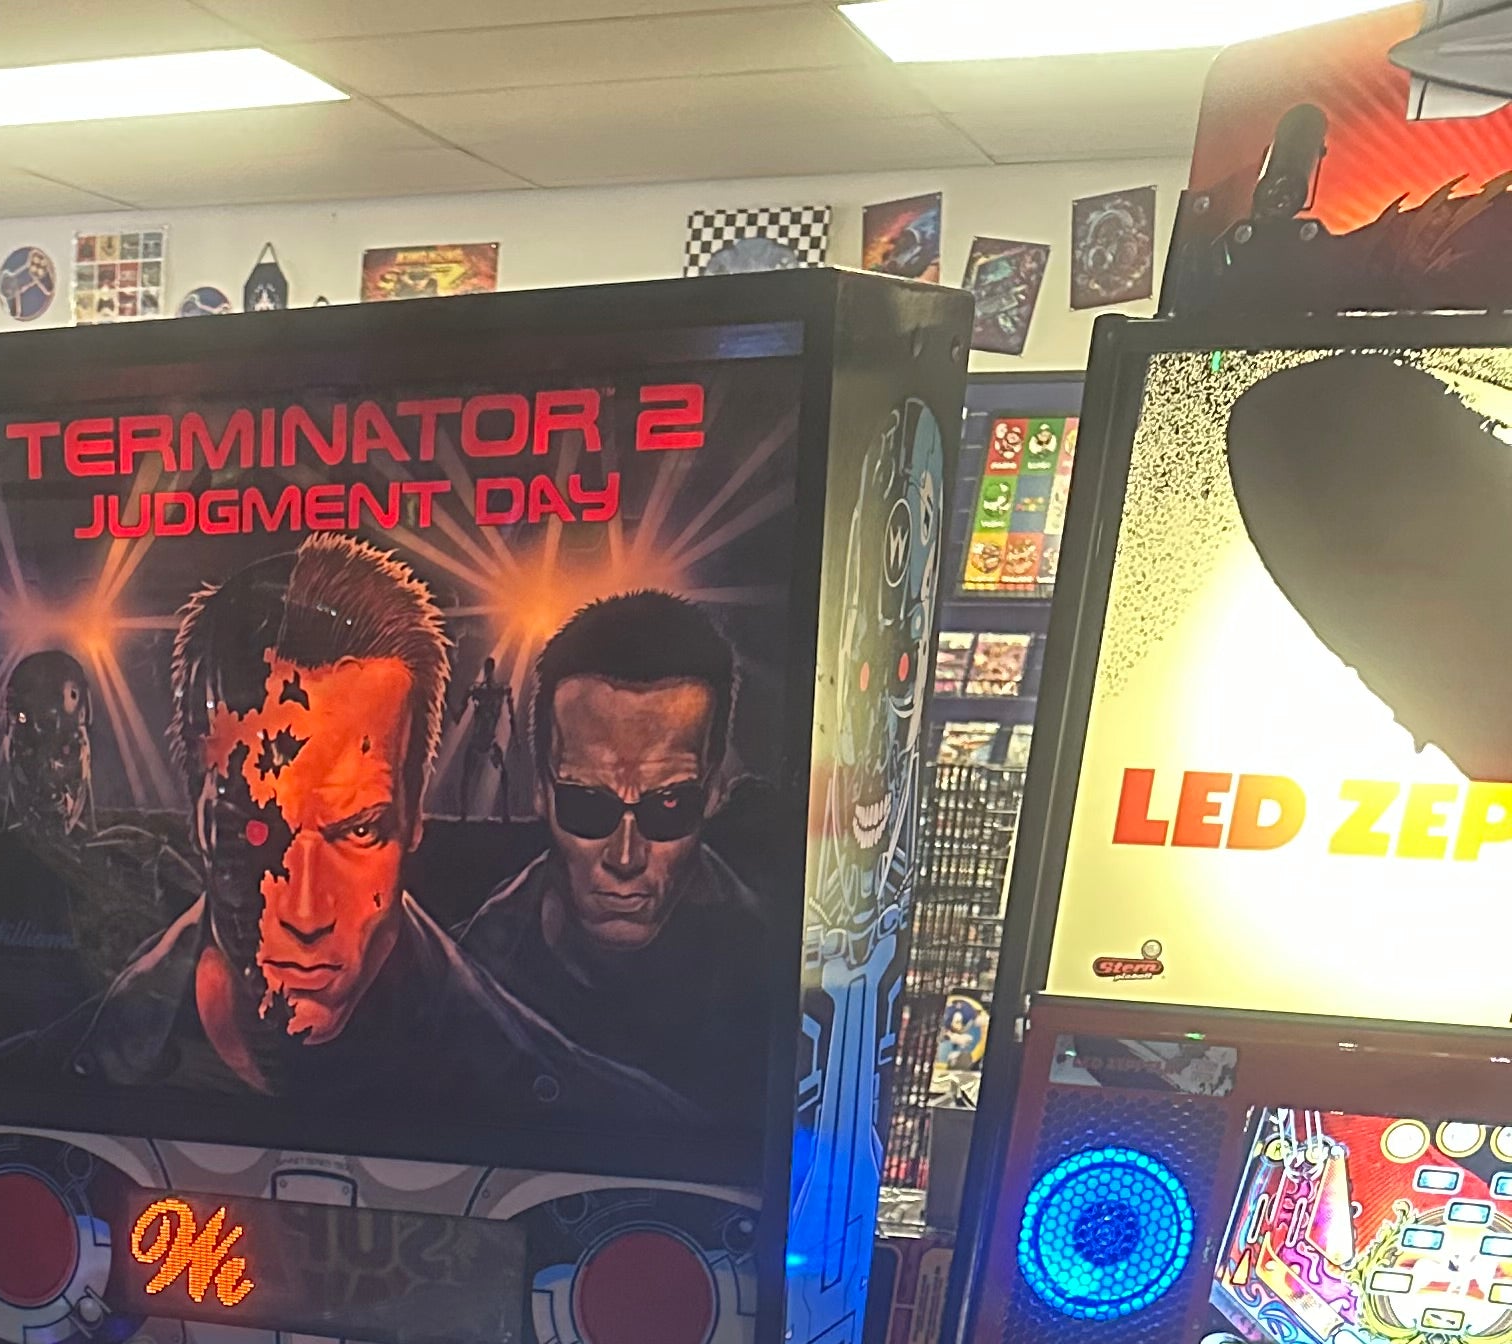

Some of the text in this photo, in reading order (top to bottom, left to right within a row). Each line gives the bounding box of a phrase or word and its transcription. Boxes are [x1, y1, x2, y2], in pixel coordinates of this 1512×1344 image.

[6, 384, 705, 480] TERMINATOR 2
[74, 473, 621, 539] JUDGMENT DAY
[1112, 768, 1512, 862] LED ZEP
[1100, 961, 1158, 974] Stern
